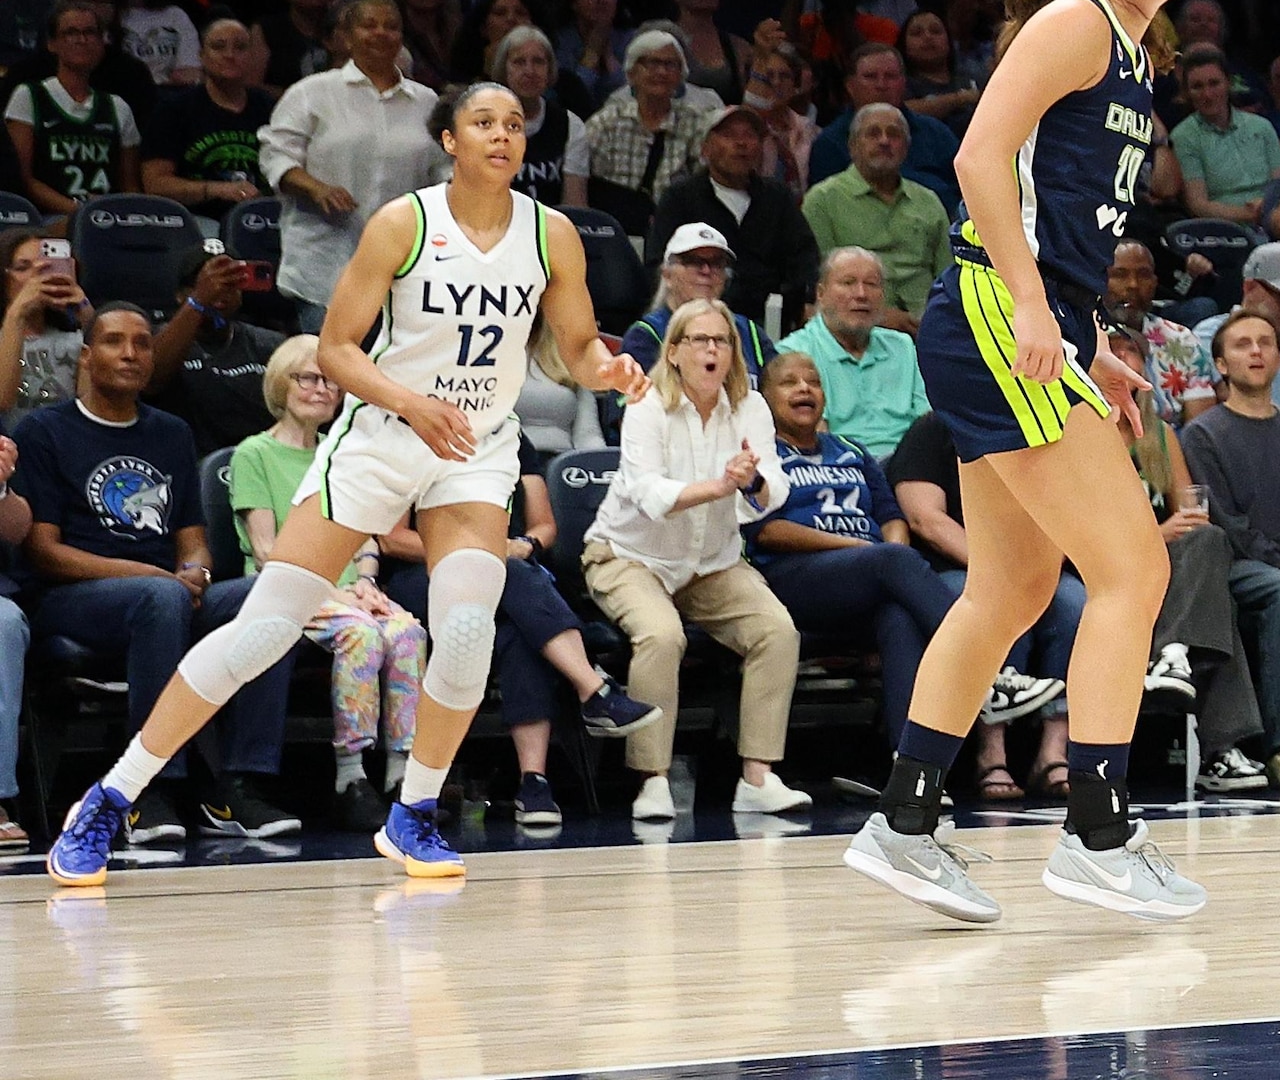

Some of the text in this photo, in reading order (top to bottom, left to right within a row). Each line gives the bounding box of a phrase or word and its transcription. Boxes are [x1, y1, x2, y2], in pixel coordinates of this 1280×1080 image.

[50, 141, 110, 164] LYNX
[116, 214, 184, 228] LEXUS
[1196, 236, 1249, 247] LEXUS
[421, 280, 535, 317] LYNX
[456, 324, 503, 366] 12
[434, 375, 498, 392] MAYO
[812, 514, 871, 533] MAYO
